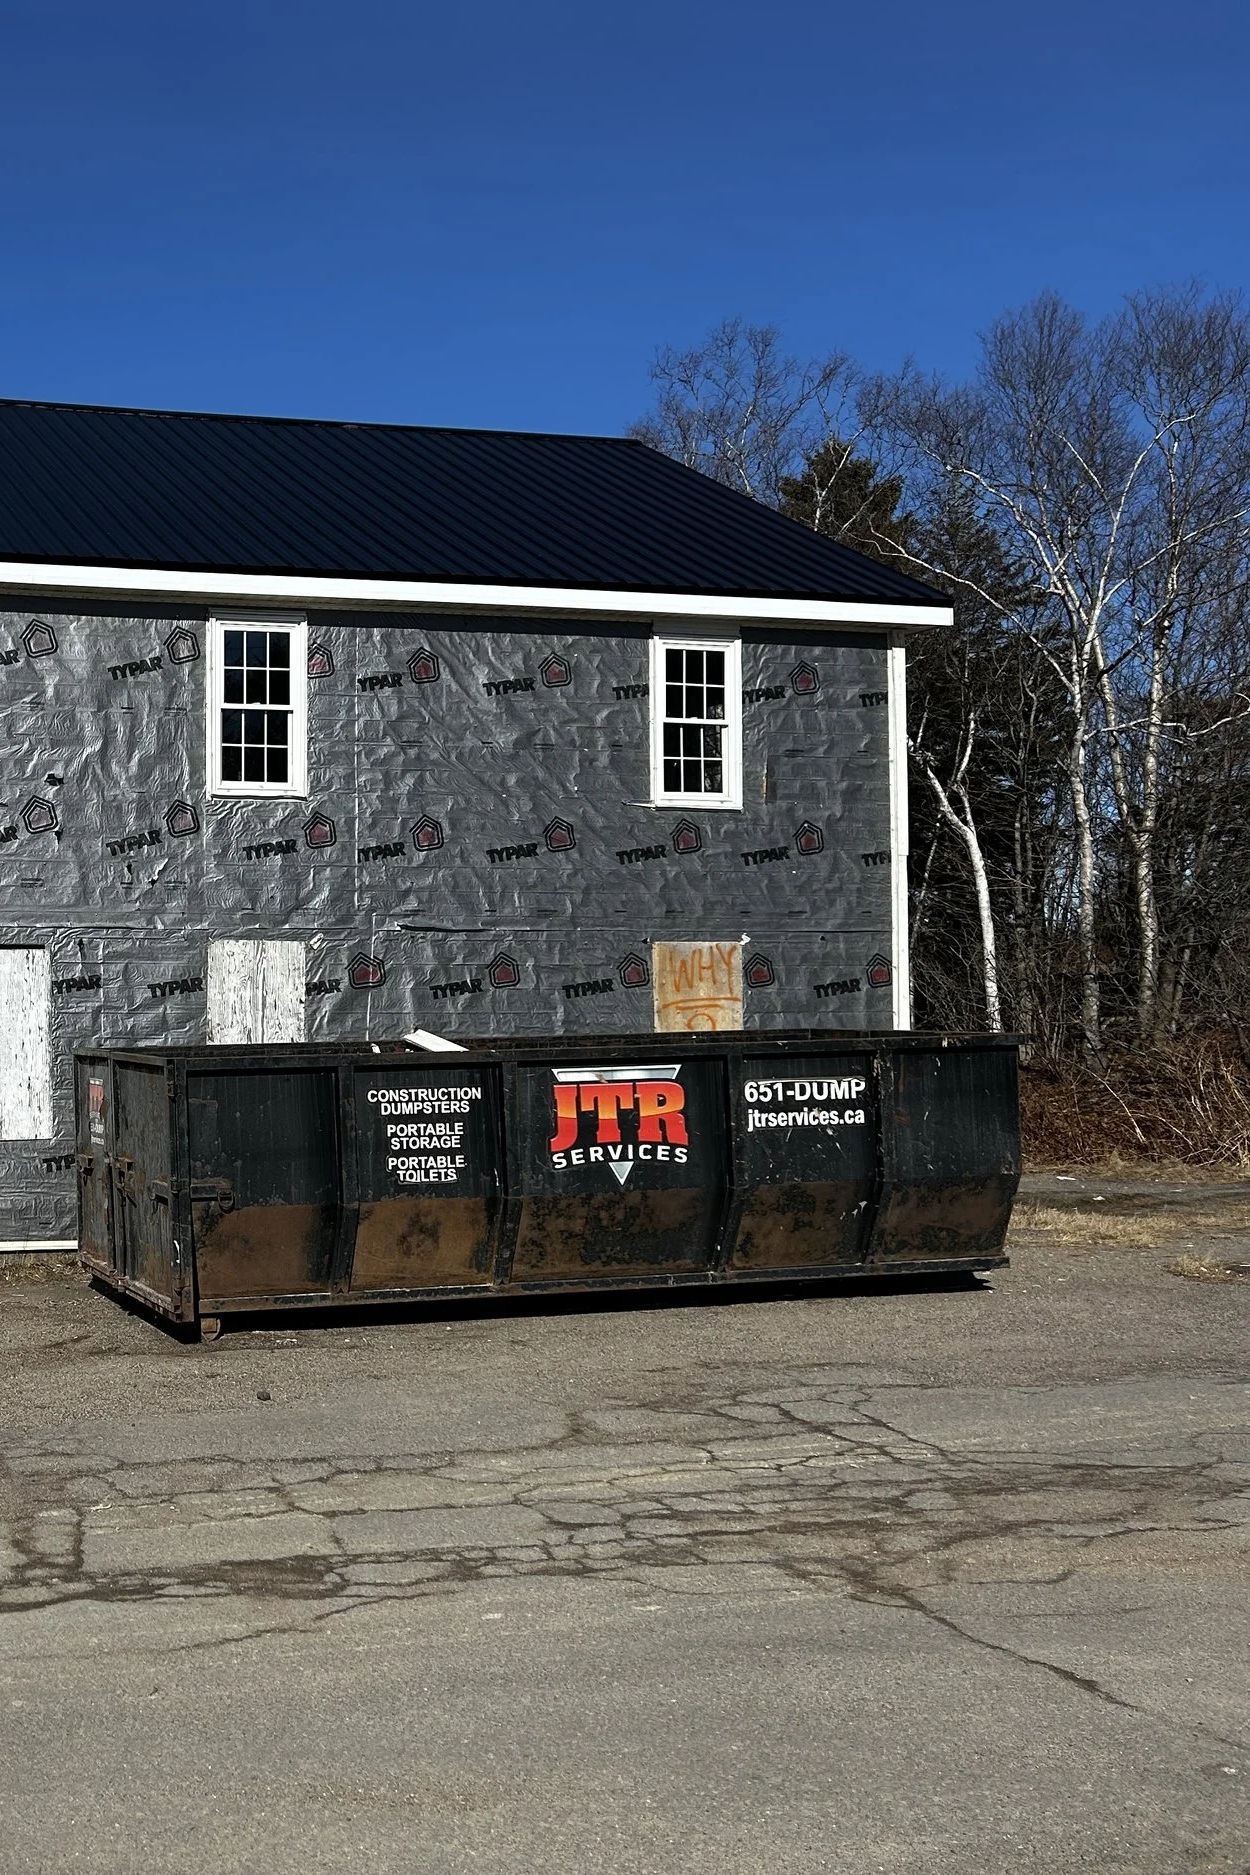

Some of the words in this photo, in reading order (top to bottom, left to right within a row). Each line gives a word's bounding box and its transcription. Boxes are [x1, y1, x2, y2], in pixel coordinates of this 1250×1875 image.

[108, 657, 163, 681] TYPAR
[357, 673, 403, 692] YPAR
[482, 677, 535, 696] TYPAR
[612, 683, 649, 700] TYPA
[859, 691, 888, 707] TYP
[106, 830, 162, 856] TYPAR
[243, 839, 298, 861] TYPAR
[486, 843, 539, 863] TYPAR
[616, 845, 667, 865] TYPAR
[741, 846, 790, 866] TYPAR
[862, 851, 892, 867] TYP
[670, 944, 736, 994] WHY
[52, 975, 101, 994] YPAR
[148, 977, 203, 998] TYPAR
[305, 978, 342, 996] PAR
[430, 979, 483, 999] TYPAR
[562, 979, 614, 999] TYPAR
[814, 979, 861, 998] TYPAR
[367, 1087, 481, 1102] CONSTRUCTION
[744, 1078, 866, 1103] 651-DUMP
[381, 1100, 470, 1115] DUMPSTERS
[550, 1081, 689, 1151] JTR
[748, 1107, 865, 1132] jtrservices.ca
[387, 1123, 464, 1137] PORTABLE
[391, 1135, 461, 1150] STORAGE
[43, 1155, 75, 1172] TYP
[388, 1156, 465, 1170] PORTABLE
[552, 1144, 688, 1170] SERVICES
[397, 1169, 457, 1183] TOILETS
